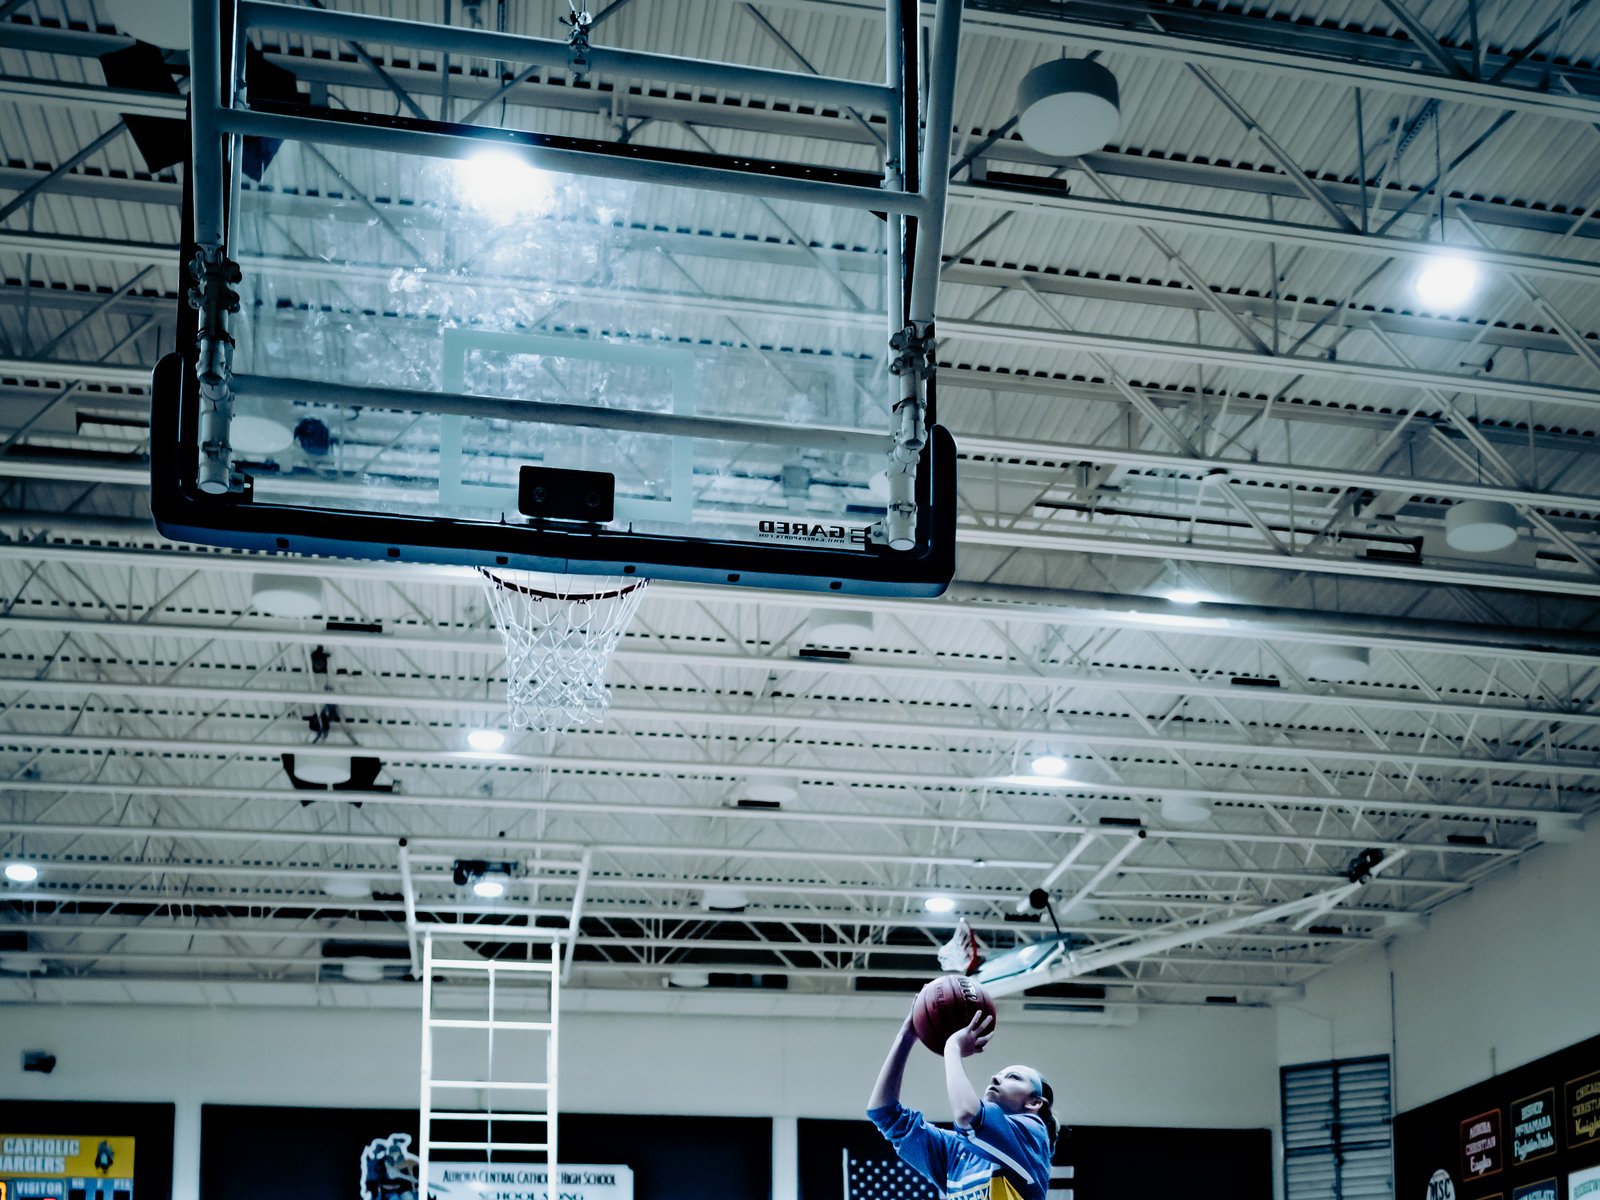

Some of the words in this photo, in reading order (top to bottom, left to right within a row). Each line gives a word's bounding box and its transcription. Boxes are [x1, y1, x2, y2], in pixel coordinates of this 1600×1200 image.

[4, 1138, 80, 1156] CATHOLIC
[0, 1156, 65, 1173] ARGERS
[560, 1172, 582, 1185] HIGH
[582, 1172, 617, 1186] SCHOOL
[16, 1181, 63, 1195] VISITOR
